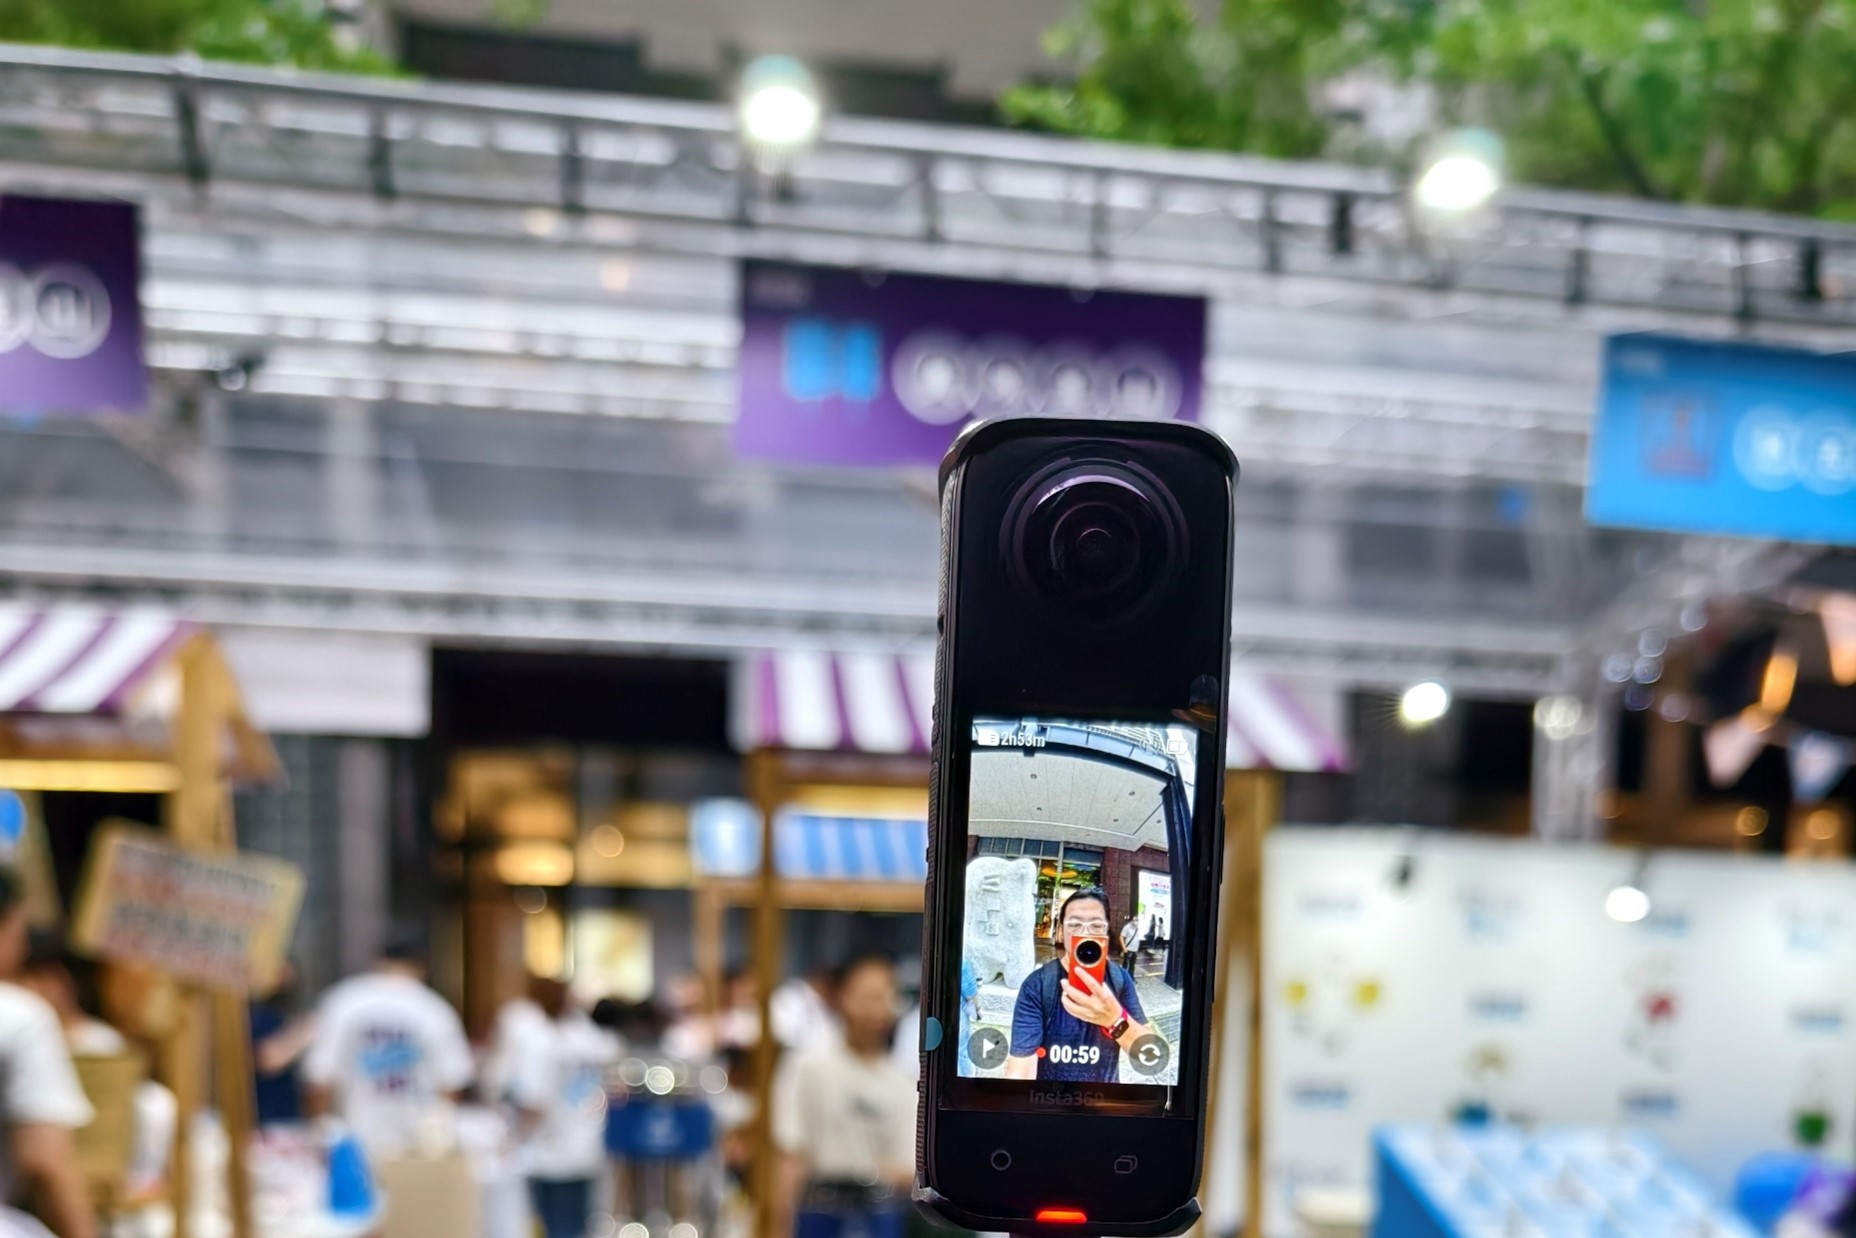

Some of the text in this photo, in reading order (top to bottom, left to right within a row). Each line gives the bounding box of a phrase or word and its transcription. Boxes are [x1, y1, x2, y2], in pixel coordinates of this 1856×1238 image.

[1001, 731, 1046, 748] 2h53m
[1049, 1044, 1100, 1065] 00:59
[1029, 1088, 1105, 1107] Insta360
